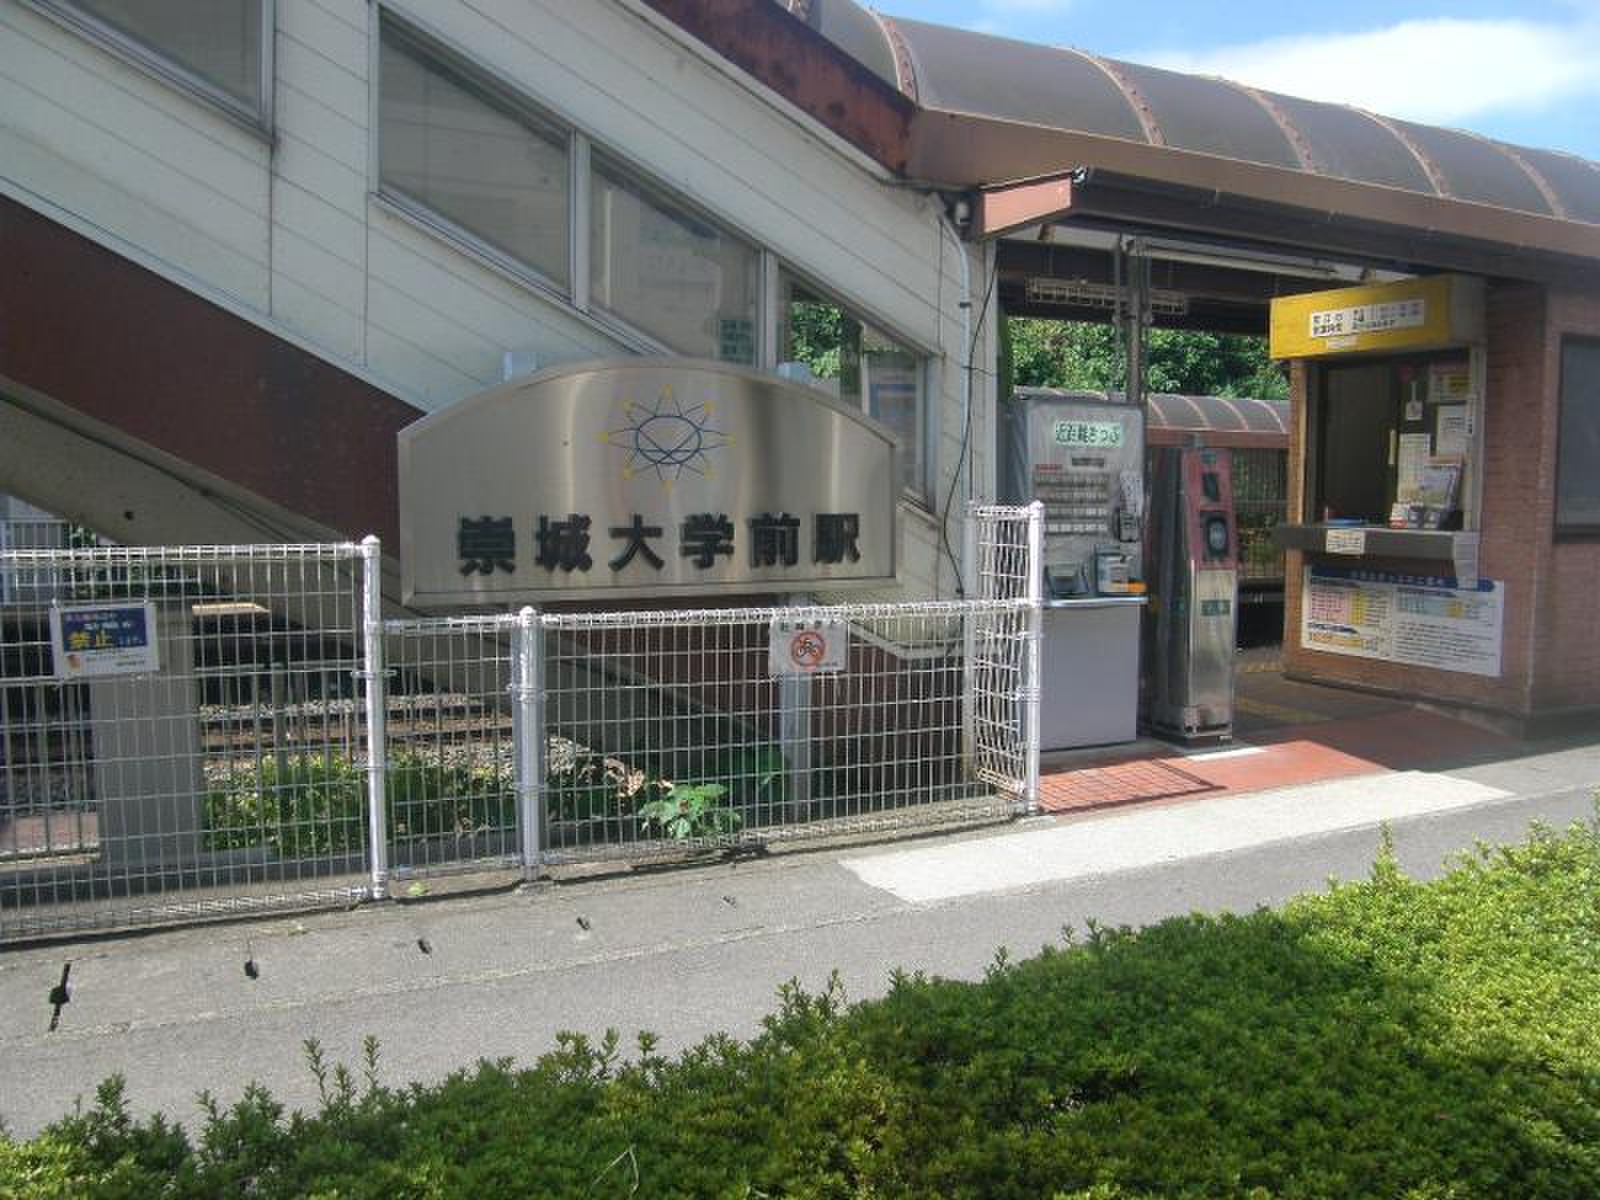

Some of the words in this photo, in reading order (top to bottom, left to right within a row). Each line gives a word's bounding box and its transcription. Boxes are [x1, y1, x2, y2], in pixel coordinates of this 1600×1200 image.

[458, 513, 862, 575] 崇城大学前駅
